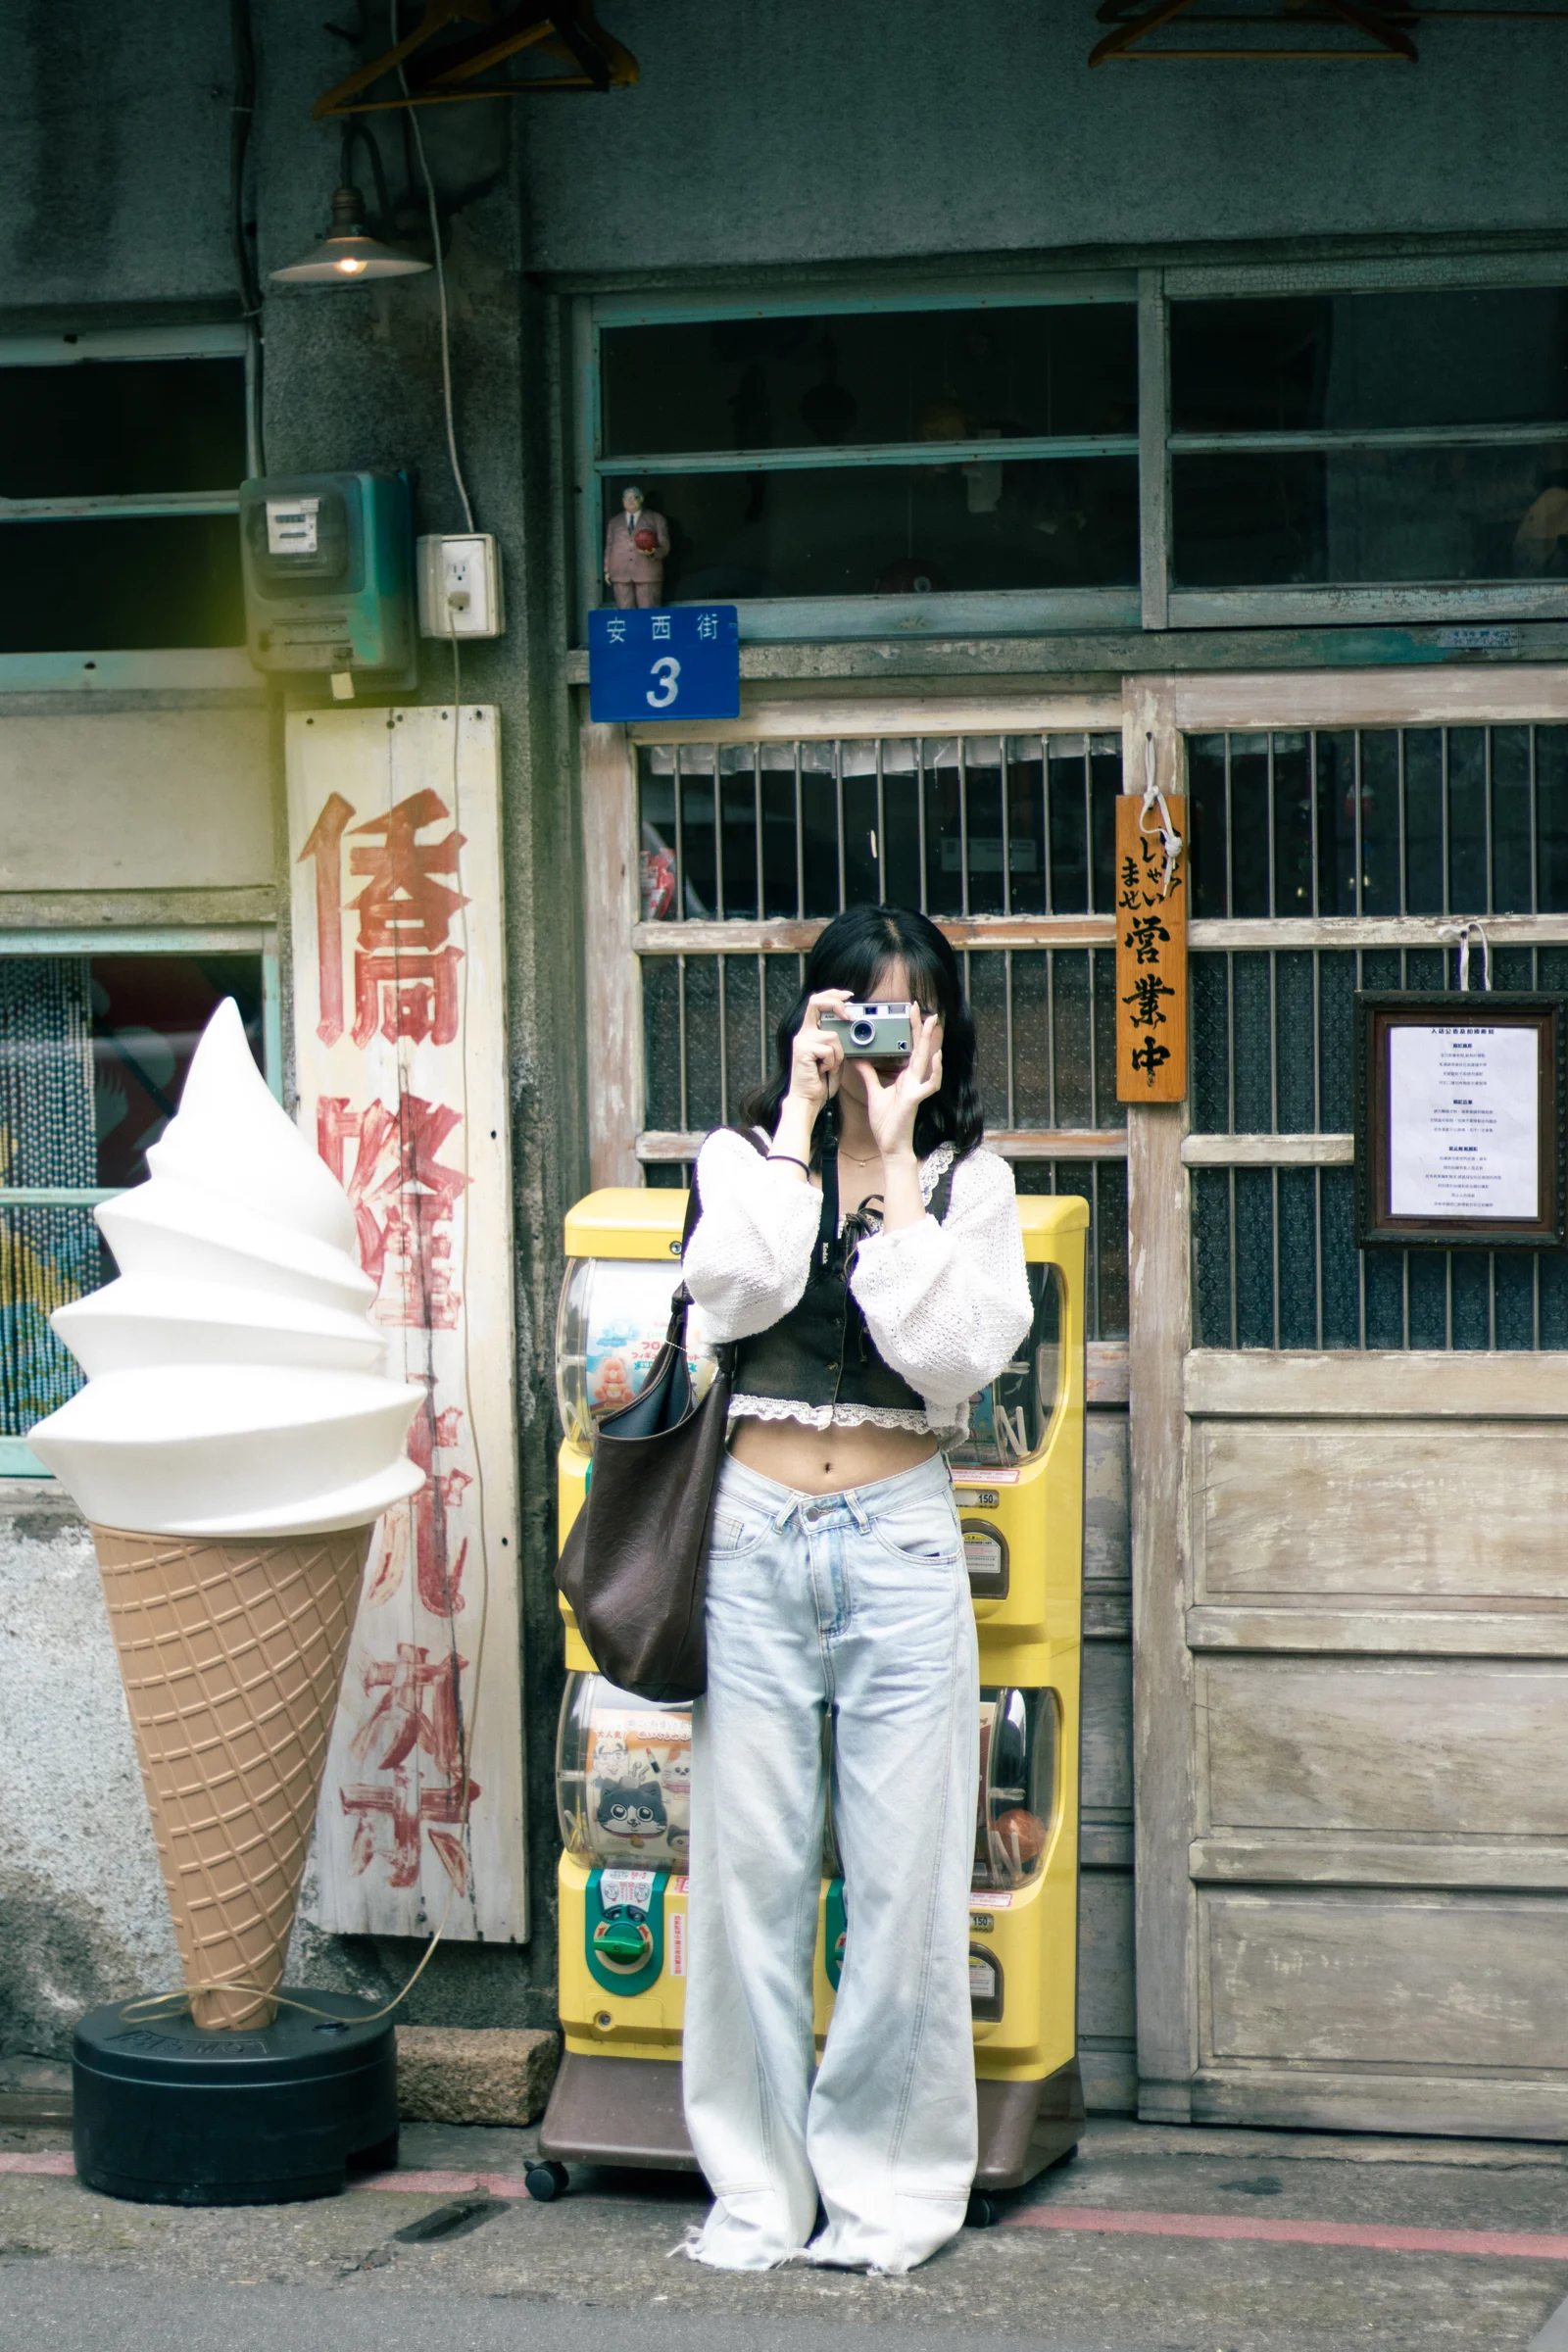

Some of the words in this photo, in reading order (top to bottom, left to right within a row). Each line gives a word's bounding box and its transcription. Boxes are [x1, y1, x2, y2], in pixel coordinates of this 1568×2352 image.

[607, 612, 718, 644] 安西街
[646, 656, 681, 709] 3
[1122, 915, 1175, 1088] 営業中
[978, 1494, 994, 1504] 150
[973, 1917, 988, 1926] 150
